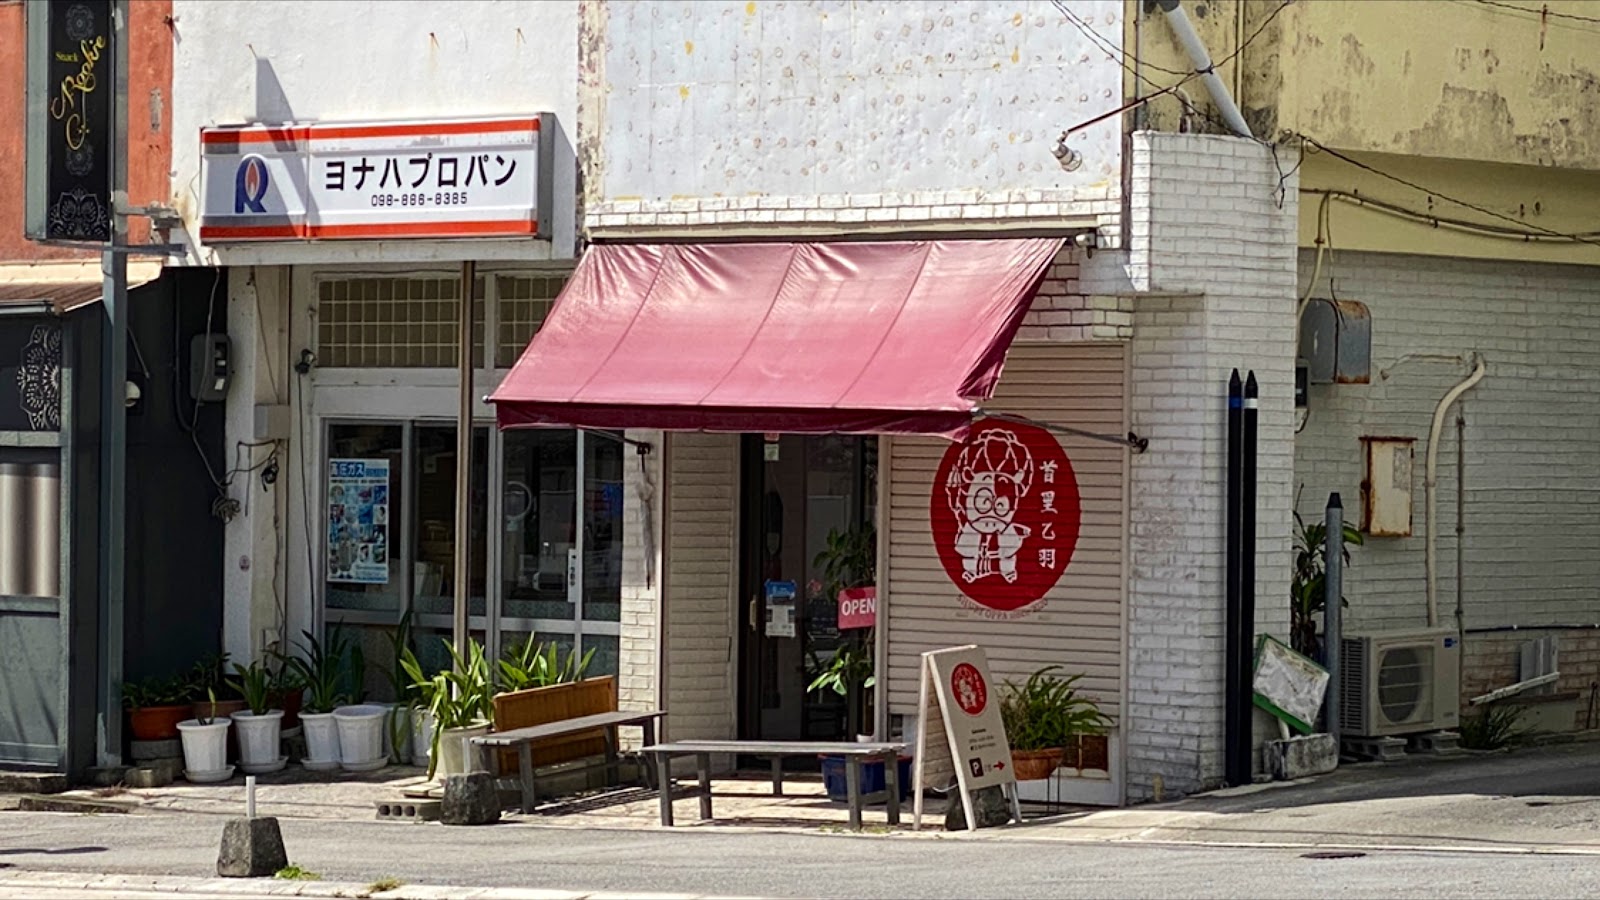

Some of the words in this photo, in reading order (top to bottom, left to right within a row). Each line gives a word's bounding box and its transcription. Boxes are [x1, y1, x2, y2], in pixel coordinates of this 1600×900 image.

[325, 152, 517, 191] ヨナハプロパン
[371, 192, 468, 207] 098-886-8385
[1038, 459, 1059, 570] 首里乙羽
[841, 597, 875, 616] OPEN
